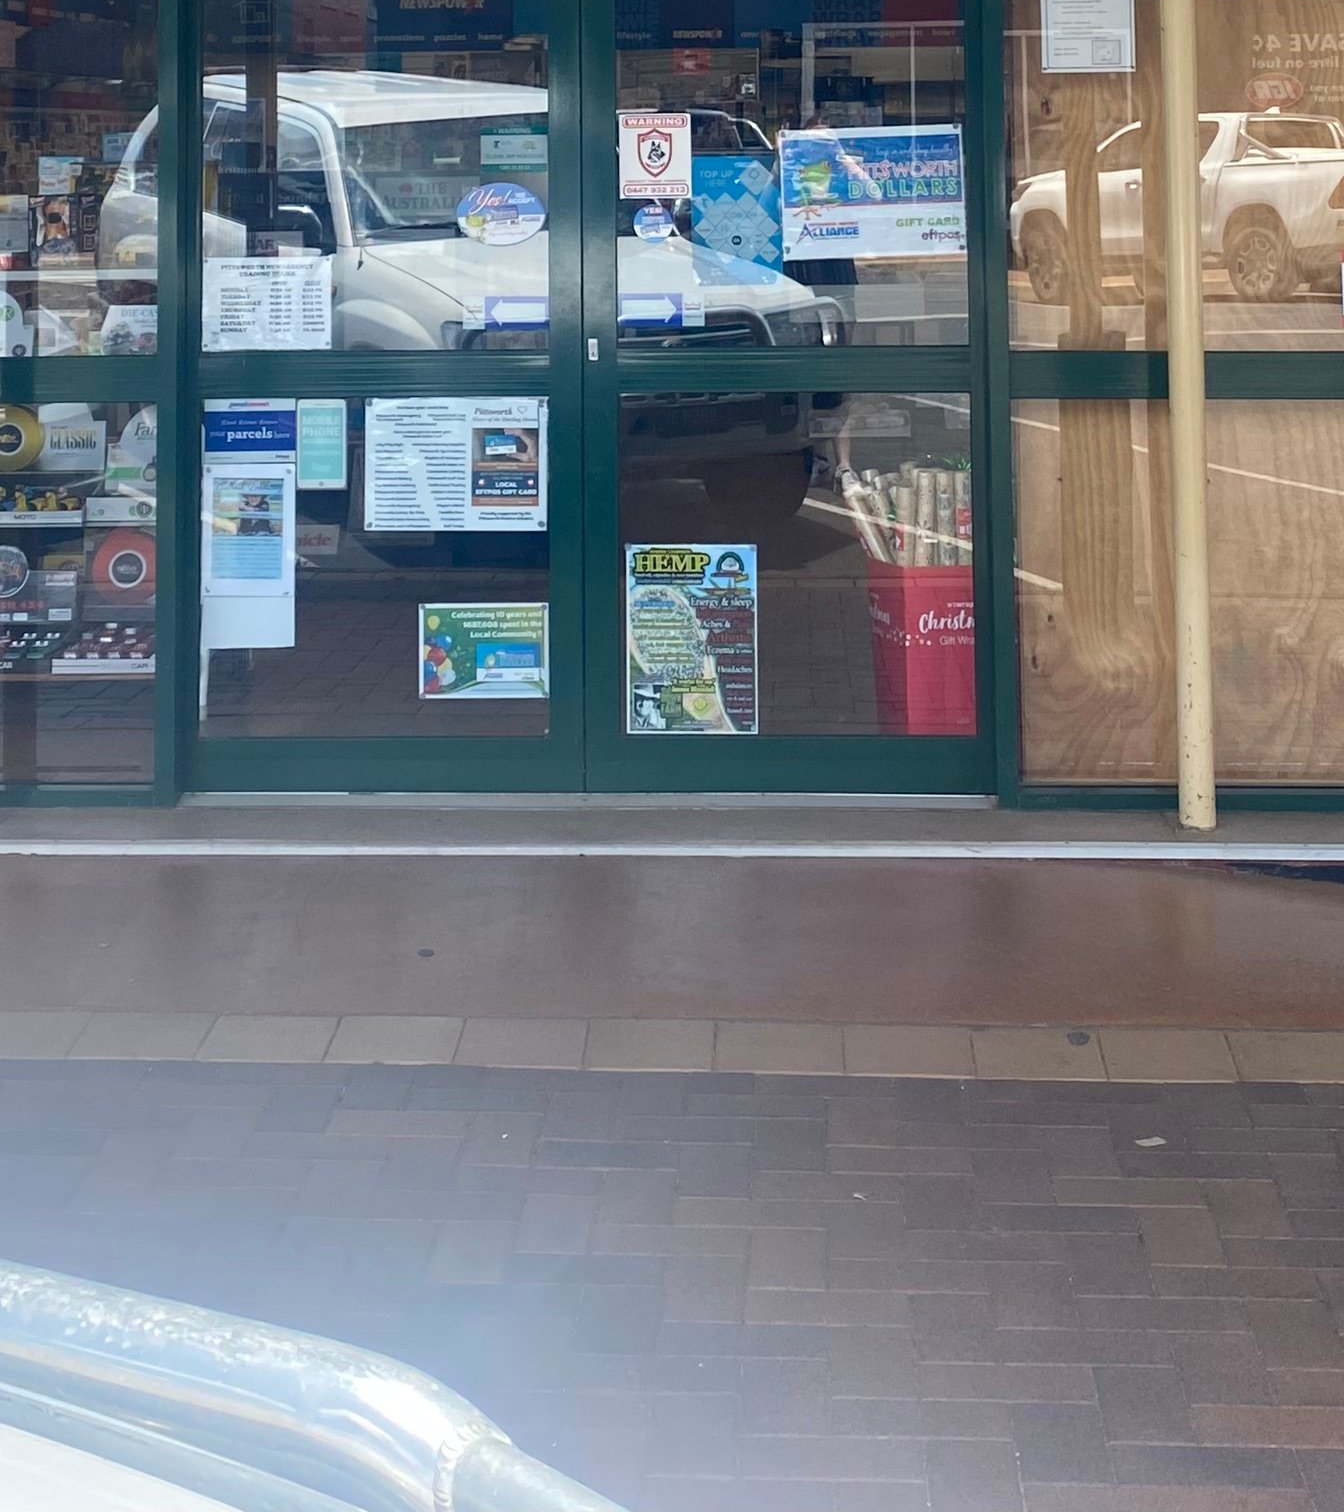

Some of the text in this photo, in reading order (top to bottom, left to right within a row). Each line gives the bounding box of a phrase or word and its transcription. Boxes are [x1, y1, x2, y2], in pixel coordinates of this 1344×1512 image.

[628, 118, 682, 126] WARNING
[848, 177, 958, 199] DOLLARS
[896, 216, 960, 227] GIFT CARD
[921, 229, 961, 242] eftpos
[50, 429, 97, 450] CLASSIC
[227, 427, 273, 443] parcels
[636, 554, 710, 573] HEMP
[690, 597, 752, 608] Energy & sleep
